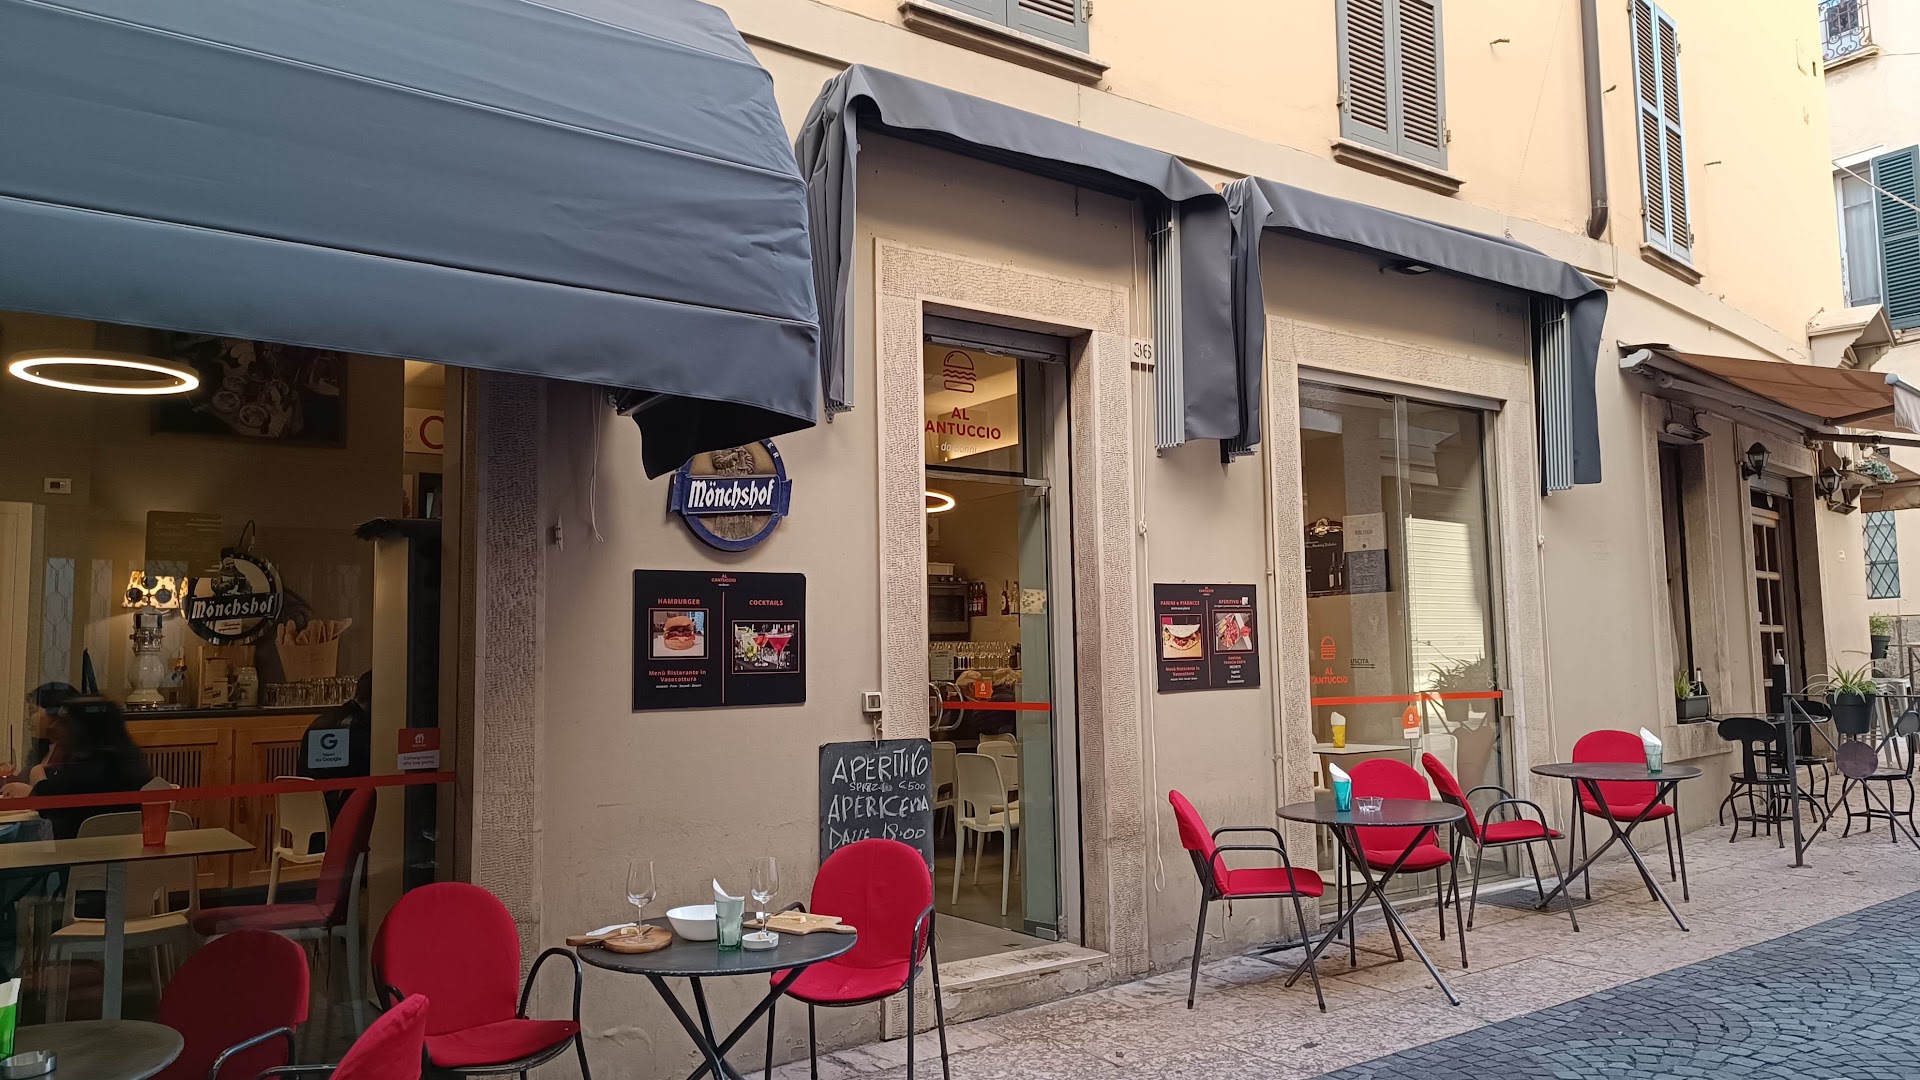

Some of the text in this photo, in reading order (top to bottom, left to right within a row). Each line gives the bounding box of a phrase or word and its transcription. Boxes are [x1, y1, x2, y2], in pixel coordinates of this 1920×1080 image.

[1133, 342, 1152, 360] 36
[951, 407, 970, 421] AL
[925, 420, 1001, 440] ANTUCCIO
[688, 479, 775, 509] Mönchshof
[192, 596, 274, 619] Mönchshof
[1325, 667, 1334, 675] AL
[322, 756, 342, 764] Google
[831, 745, 929, 785] APERITIVO
[827, 794, 930, 825] APERICENA
